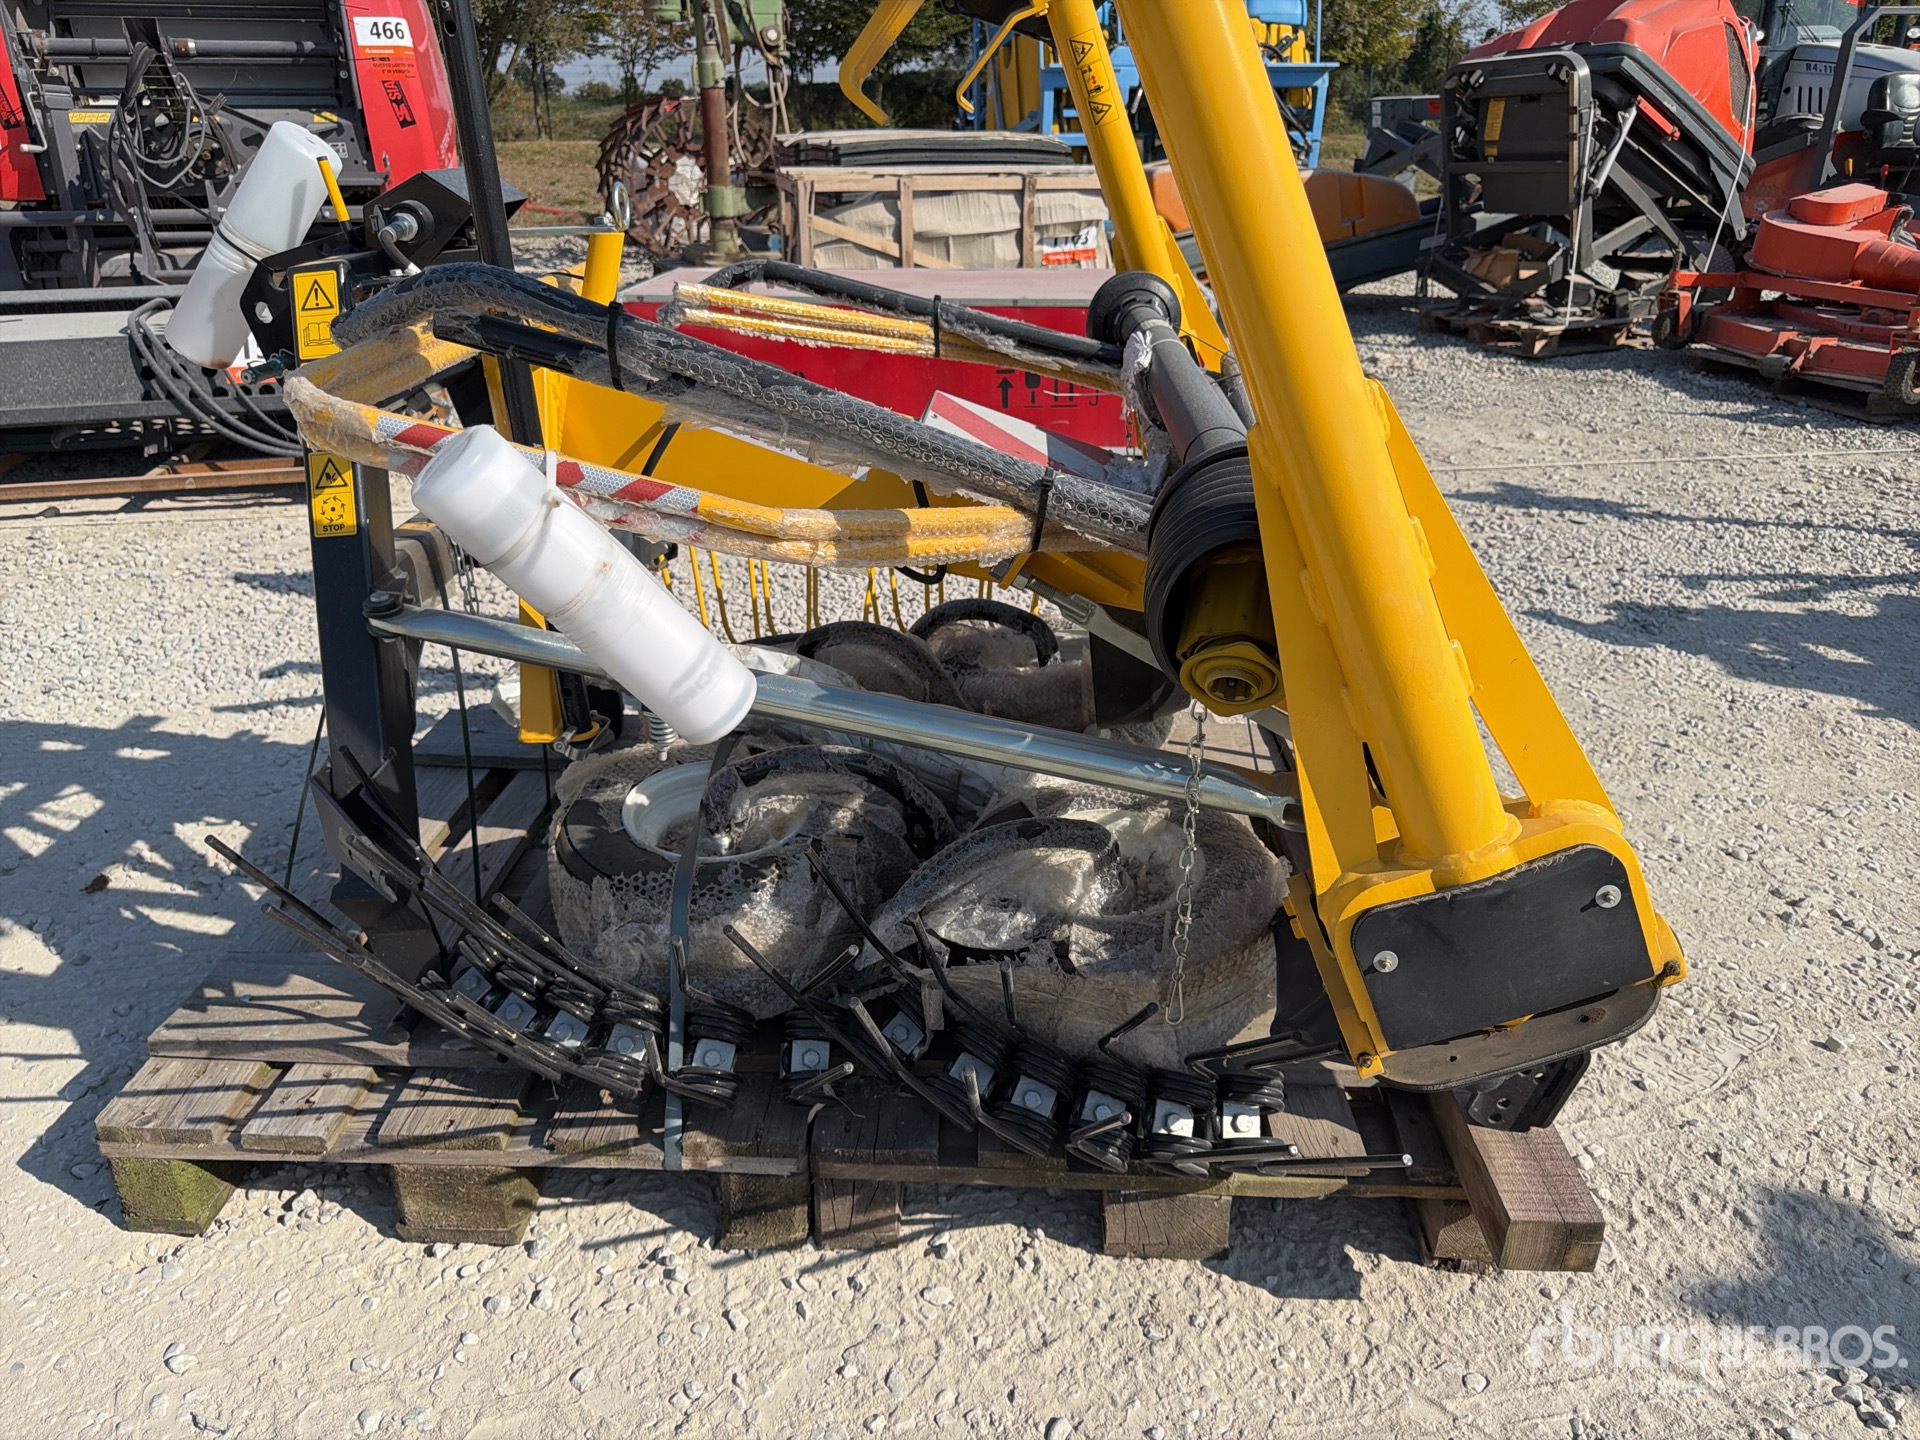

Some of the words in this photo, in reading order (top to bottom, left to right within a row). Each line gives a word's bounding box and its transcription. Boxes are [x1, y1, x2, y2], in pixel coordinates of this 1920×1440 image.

[370, 21, 405, 40] 466
[1806, 63, 1836, 73] R4.11
[322, 523, 345, 532] STOP
